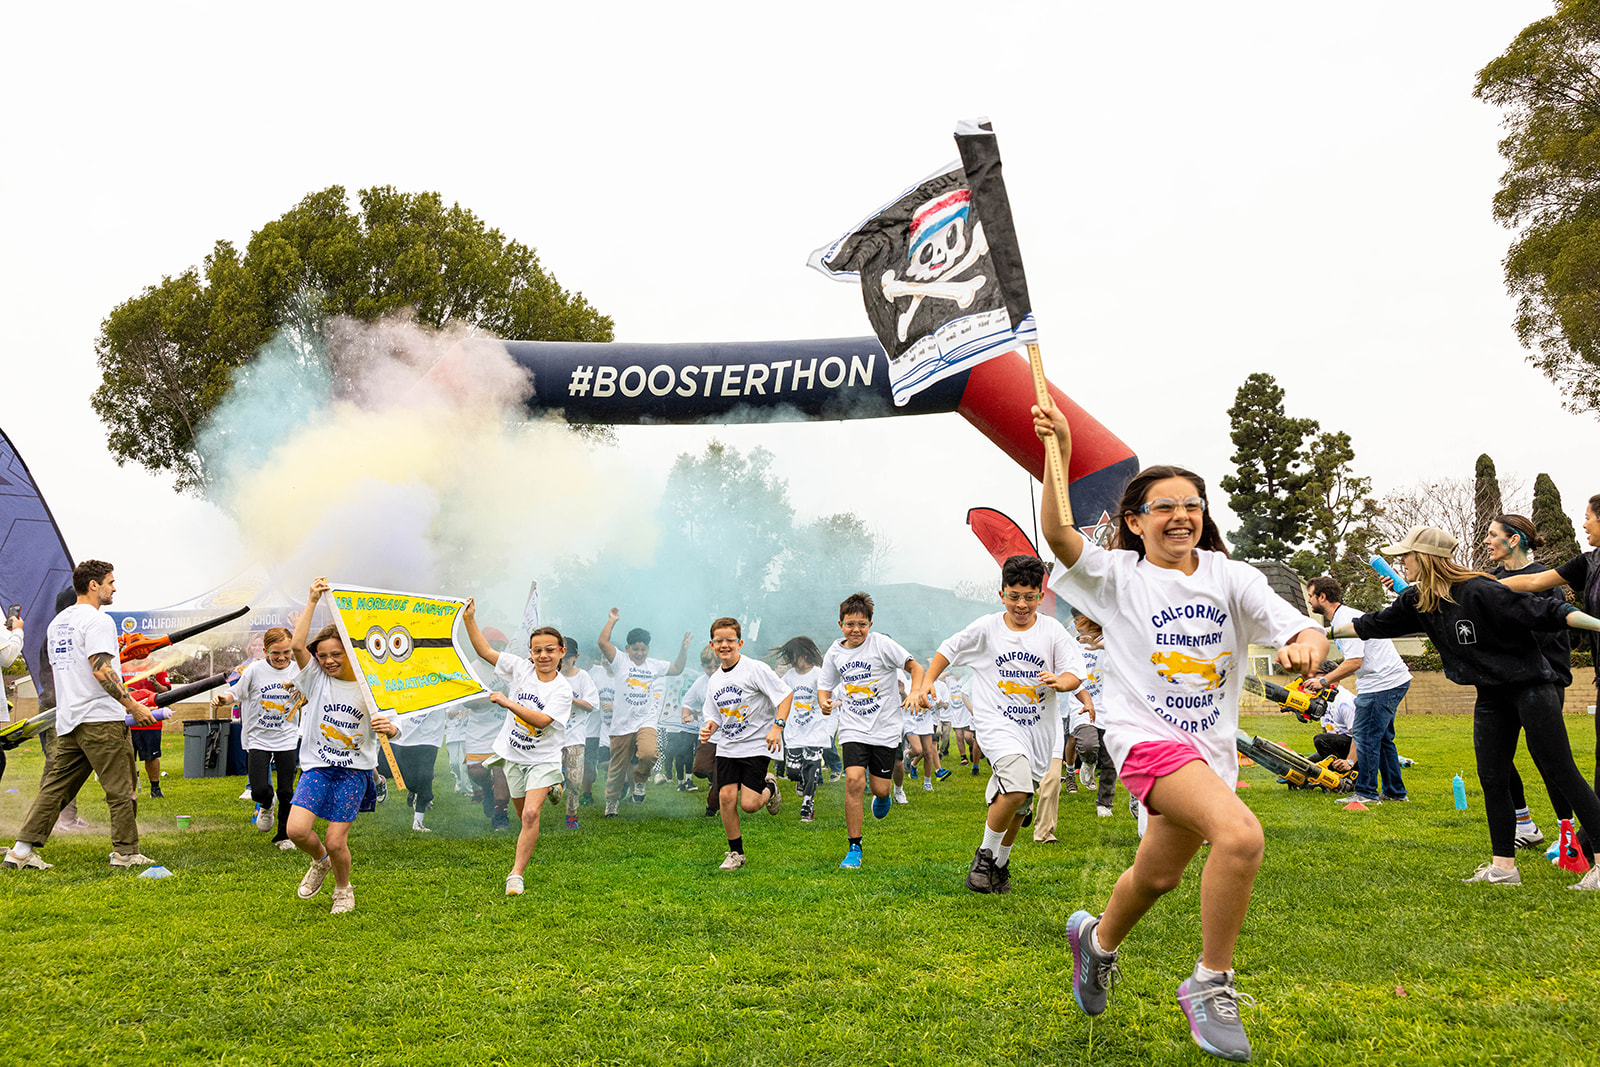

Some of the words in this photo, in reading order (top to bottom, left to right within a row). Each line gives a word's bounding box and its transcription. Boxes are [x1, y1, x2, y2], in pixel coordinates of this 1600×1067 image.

[568, 354, 876, 397] #BOOSTERTHON
[356, 597, 409, 611] MOREAUS
[142, 615, 191, 630] CALIFORNIA
[250, 613, 282, 626] SCHOOL
[1151, 604, 1228, 629] CALFORNIA
[1156, 631, 1223, 647] ELEMENTARY
[995, 651, 1045, 668] CALIFORNIA
[840, 660, 872, 676] ALIFORNIA
[260, 682, 285, 693] CALIFO
[713, 686, 743, 701] CALIFORNIA
[867, 703, 881, 714] RUN
[1166, 694, 1214, 709] COUGAR
[323, 703, 364, 721] CAIFORNIA
[1007, 705, 1037, 714] COUGAR
[323, 714, 361, 729] ELEMENTARY
[1201, 706, 1220, 731] RUN
[323, 744, 350, 757] COUGAR
